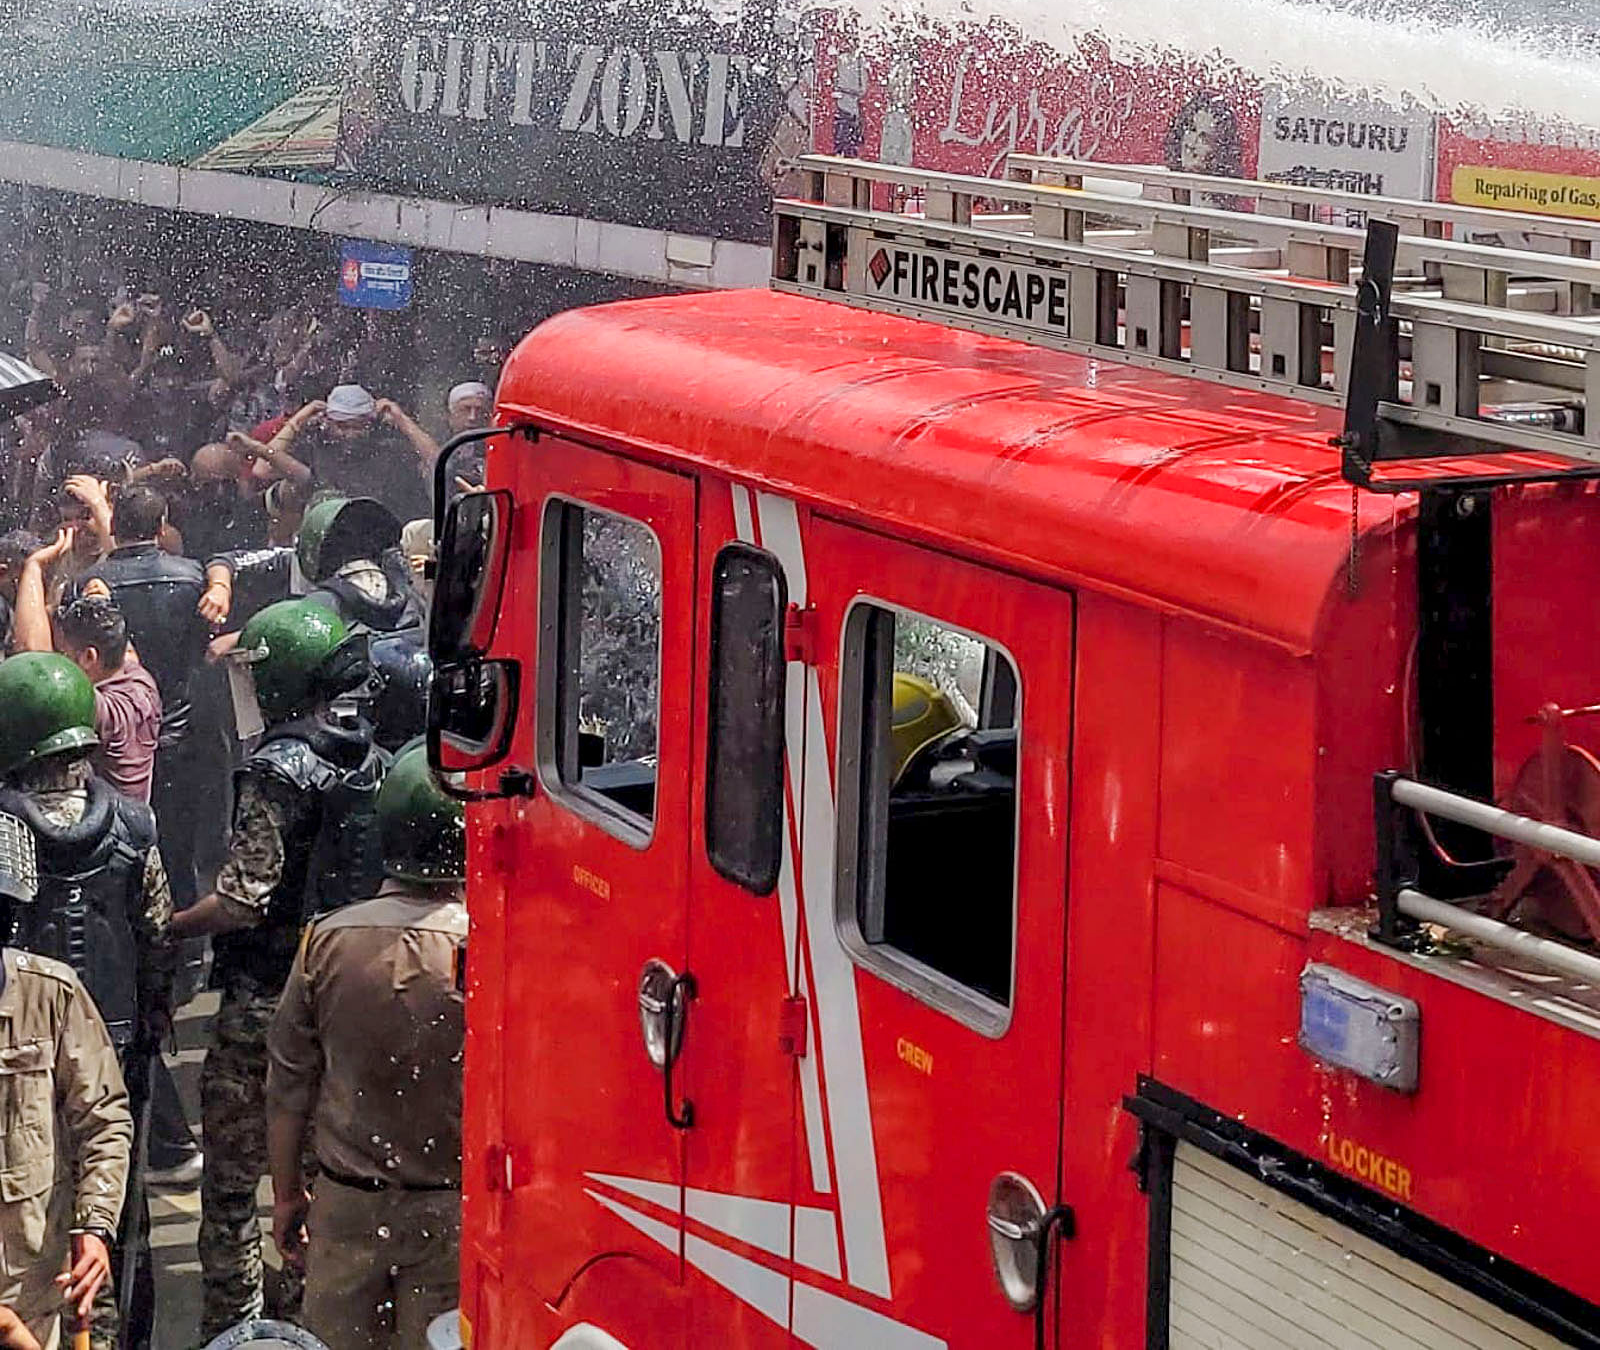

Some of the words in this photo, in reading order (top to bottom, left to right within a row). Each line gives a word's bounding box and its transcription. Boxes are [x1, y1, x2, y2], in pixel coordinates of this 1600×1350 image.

[559, 44, 749, 148] ZONE
[1273, 116, 1409, 154] SATGURU
[1474, 177, 1547, 205] Repairing
[1550, 186, 1567, 203] of
[1567, 189, 1600, 210] Gas,
[893, 250, 1067, 327] FIRESCAPE
[573, 864, 611, 902] OFFICER
[897, 1037, 934, 1076] CREW
[1328, 1131, 1412, 1202] LOCKER
